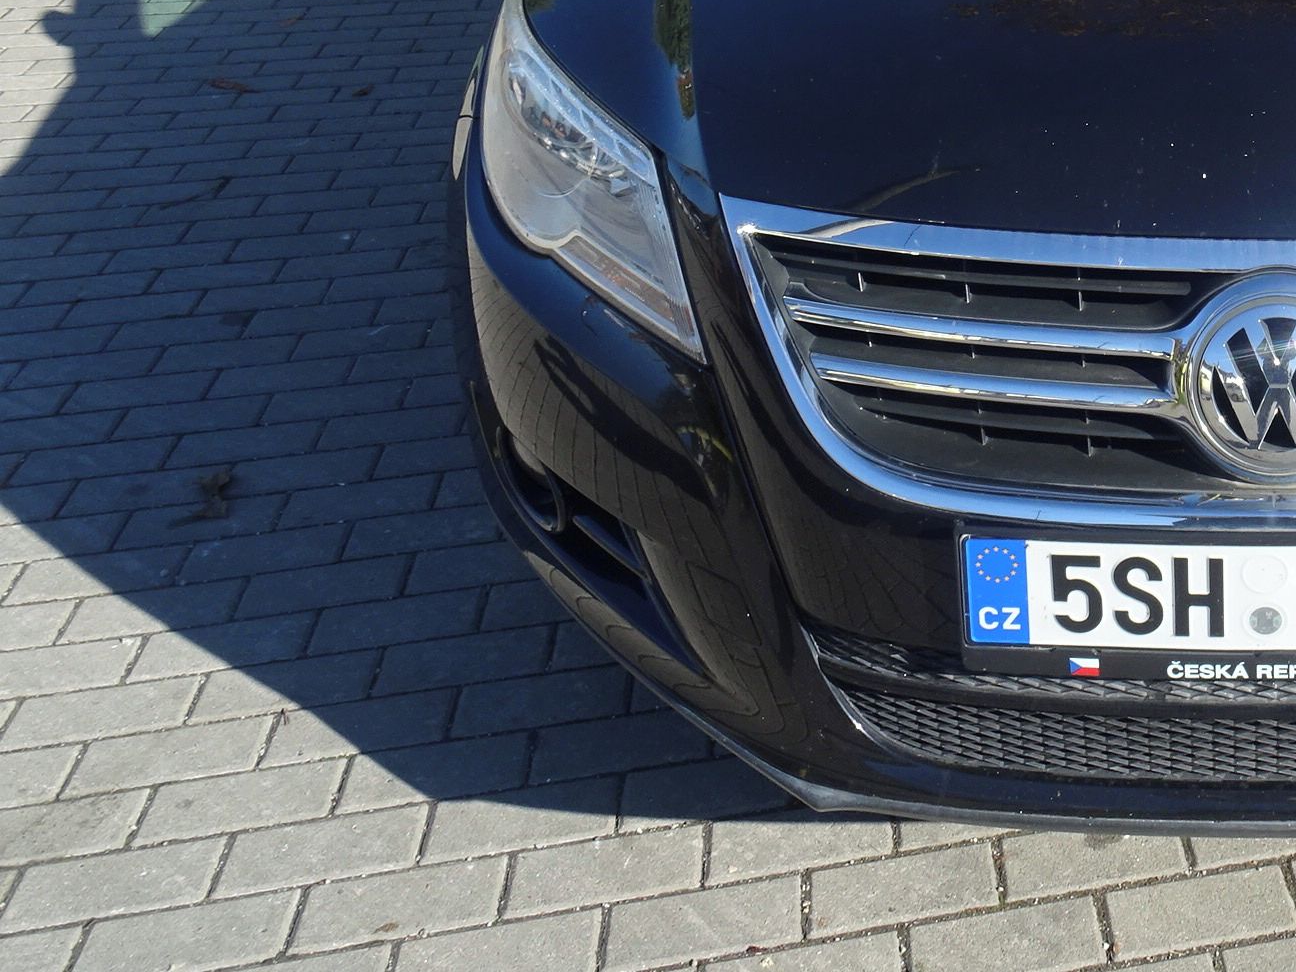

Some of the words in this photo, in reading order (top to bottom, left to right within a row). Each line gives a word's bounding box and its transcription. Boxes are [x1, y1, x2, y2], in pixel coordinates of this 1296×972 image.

[1049, 555, 1225, 638] 5SH
[978, 606, 1021, 630] CZ
[1166, 660, 1250, 681] ČESKÁ
